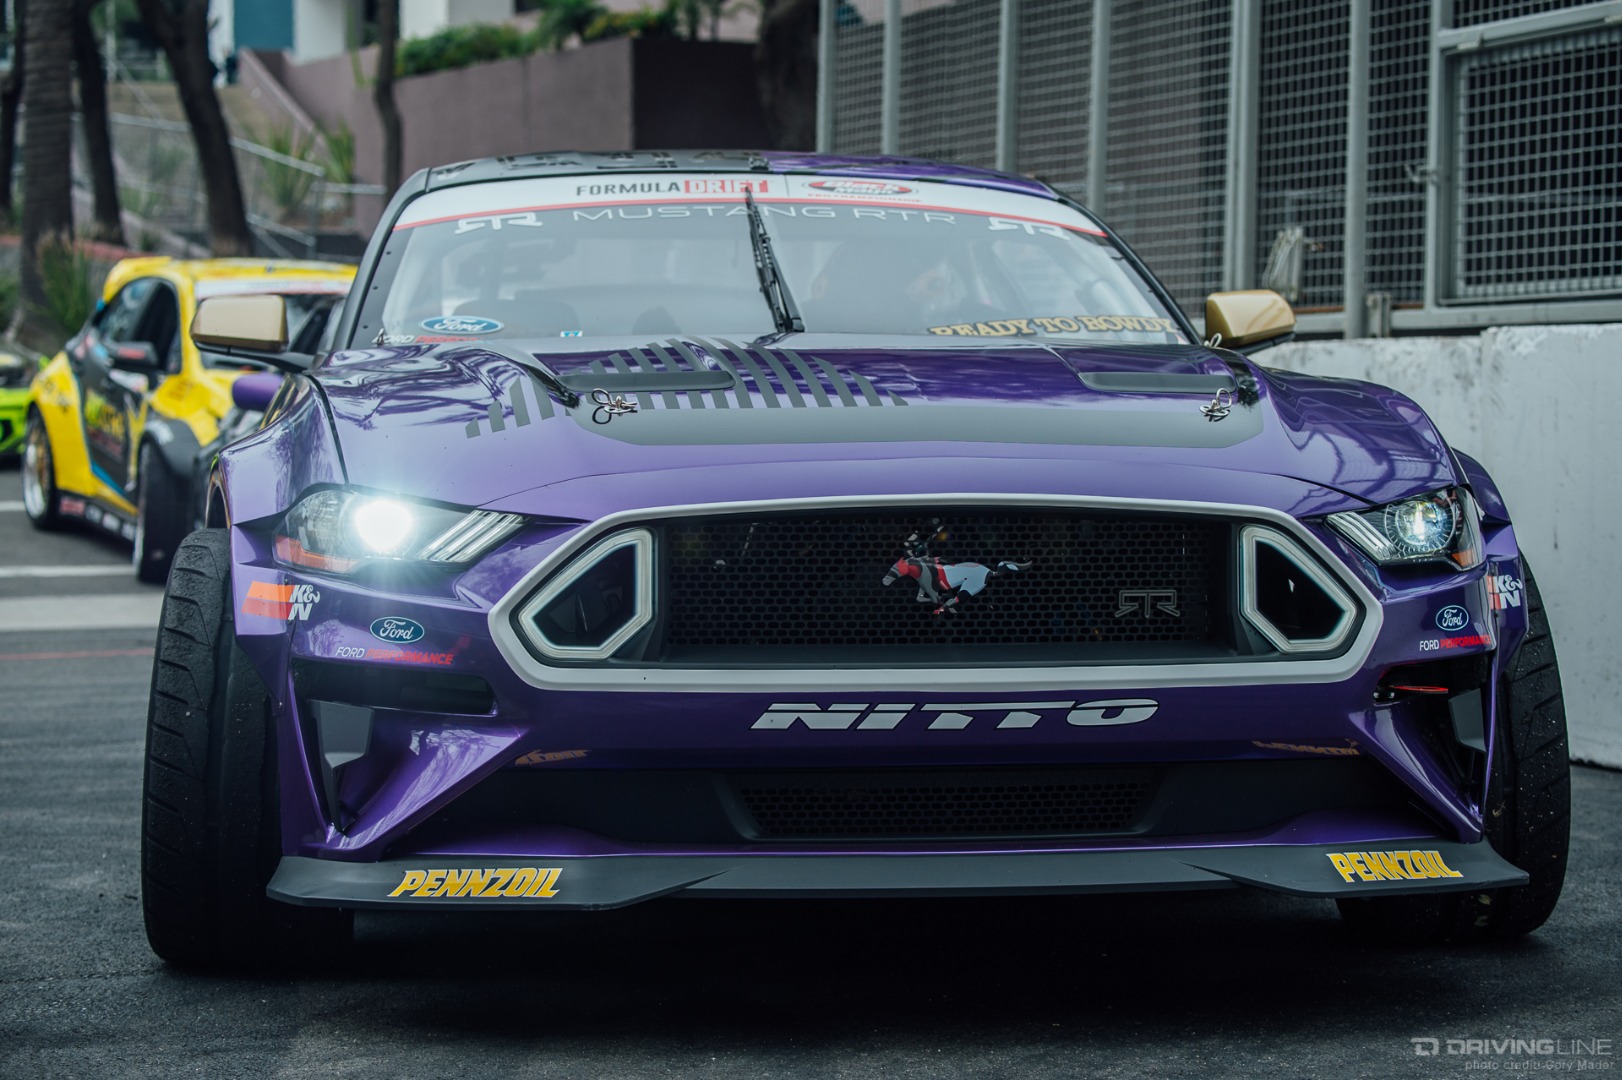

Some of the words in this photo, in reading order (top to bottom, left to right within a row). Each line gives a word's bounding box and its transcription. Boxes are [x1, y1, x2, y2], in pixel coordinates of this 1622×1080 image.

[576, 182, 681, 197] FORMULA
[688, 179, 765, 194] DRIFT
[573, 205, 836, 222] MUSTANG
[853, 208, 957, 225] RTR
[1032, 316, 1082, 333] TO
[1075, 314, 1179, 334] ROWDY
[1419, 639, 1440, 651] FORD
[335, 646, 365, 658] FORD
[366, 648, 454, 665] PERFORMANCE
[750, 698, 1159, 730] NITTO
[1326, 850, 1464, 883] PENNZOIL
[386, 867, 564, 897] PENNZOIL
